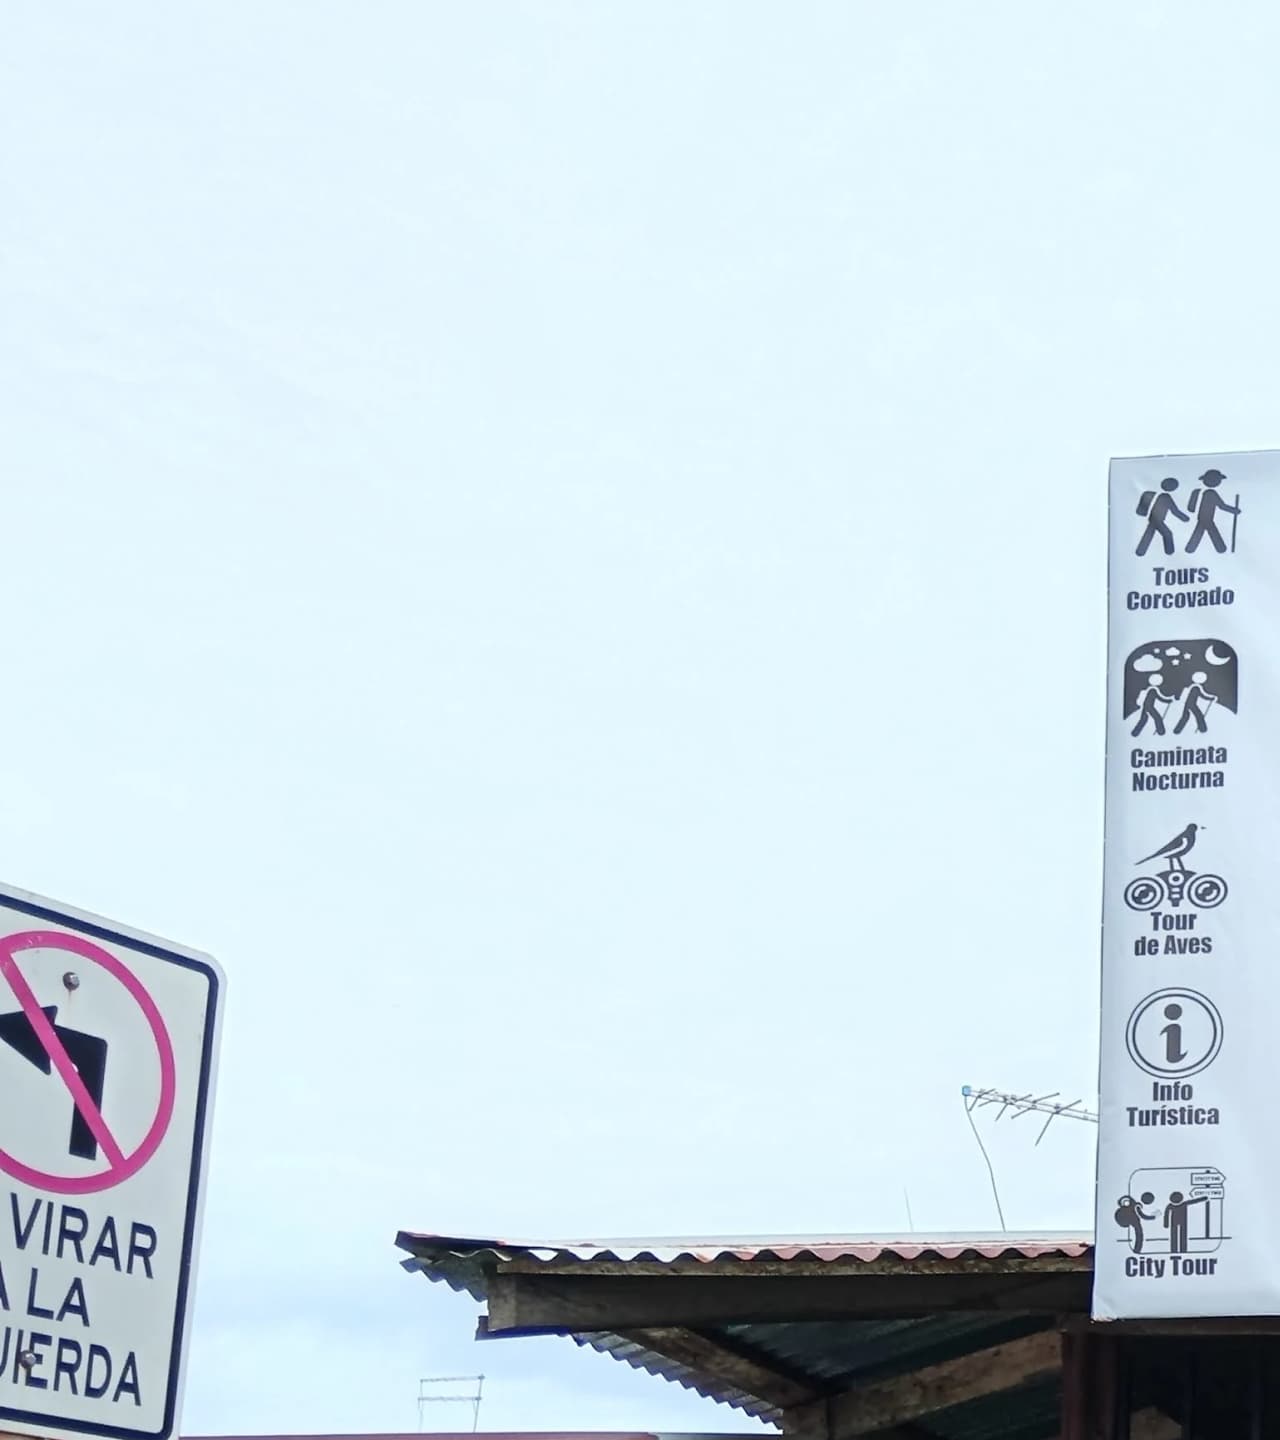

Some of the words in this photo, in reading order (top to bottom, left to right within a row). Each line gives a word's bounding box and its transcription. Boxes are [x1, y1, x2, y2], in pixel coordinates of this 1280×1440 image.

[1153, 566, 1209, 586] Tours
[1126, 587, 1235, 611] Corcovado
[1130, 745, 1228, 768] Caminata
[1132, 769, 1224, 792] Nocturna
[1150, 910, 1196, 931] Tour
[1134, 935, 1158, 957] de
[1163, 933, 1212, 955] Aves
[1152, 1082, 1193, 1102] Info
[1126, 1104, 1220, 1128] Turística
[10, 1192, 158, 1280] VIRAR
[1124, 1257, 1164, 1279] City
[1169, 1256, 1217, 1277] Tour
[27, 1267, 90, 1328] LA
